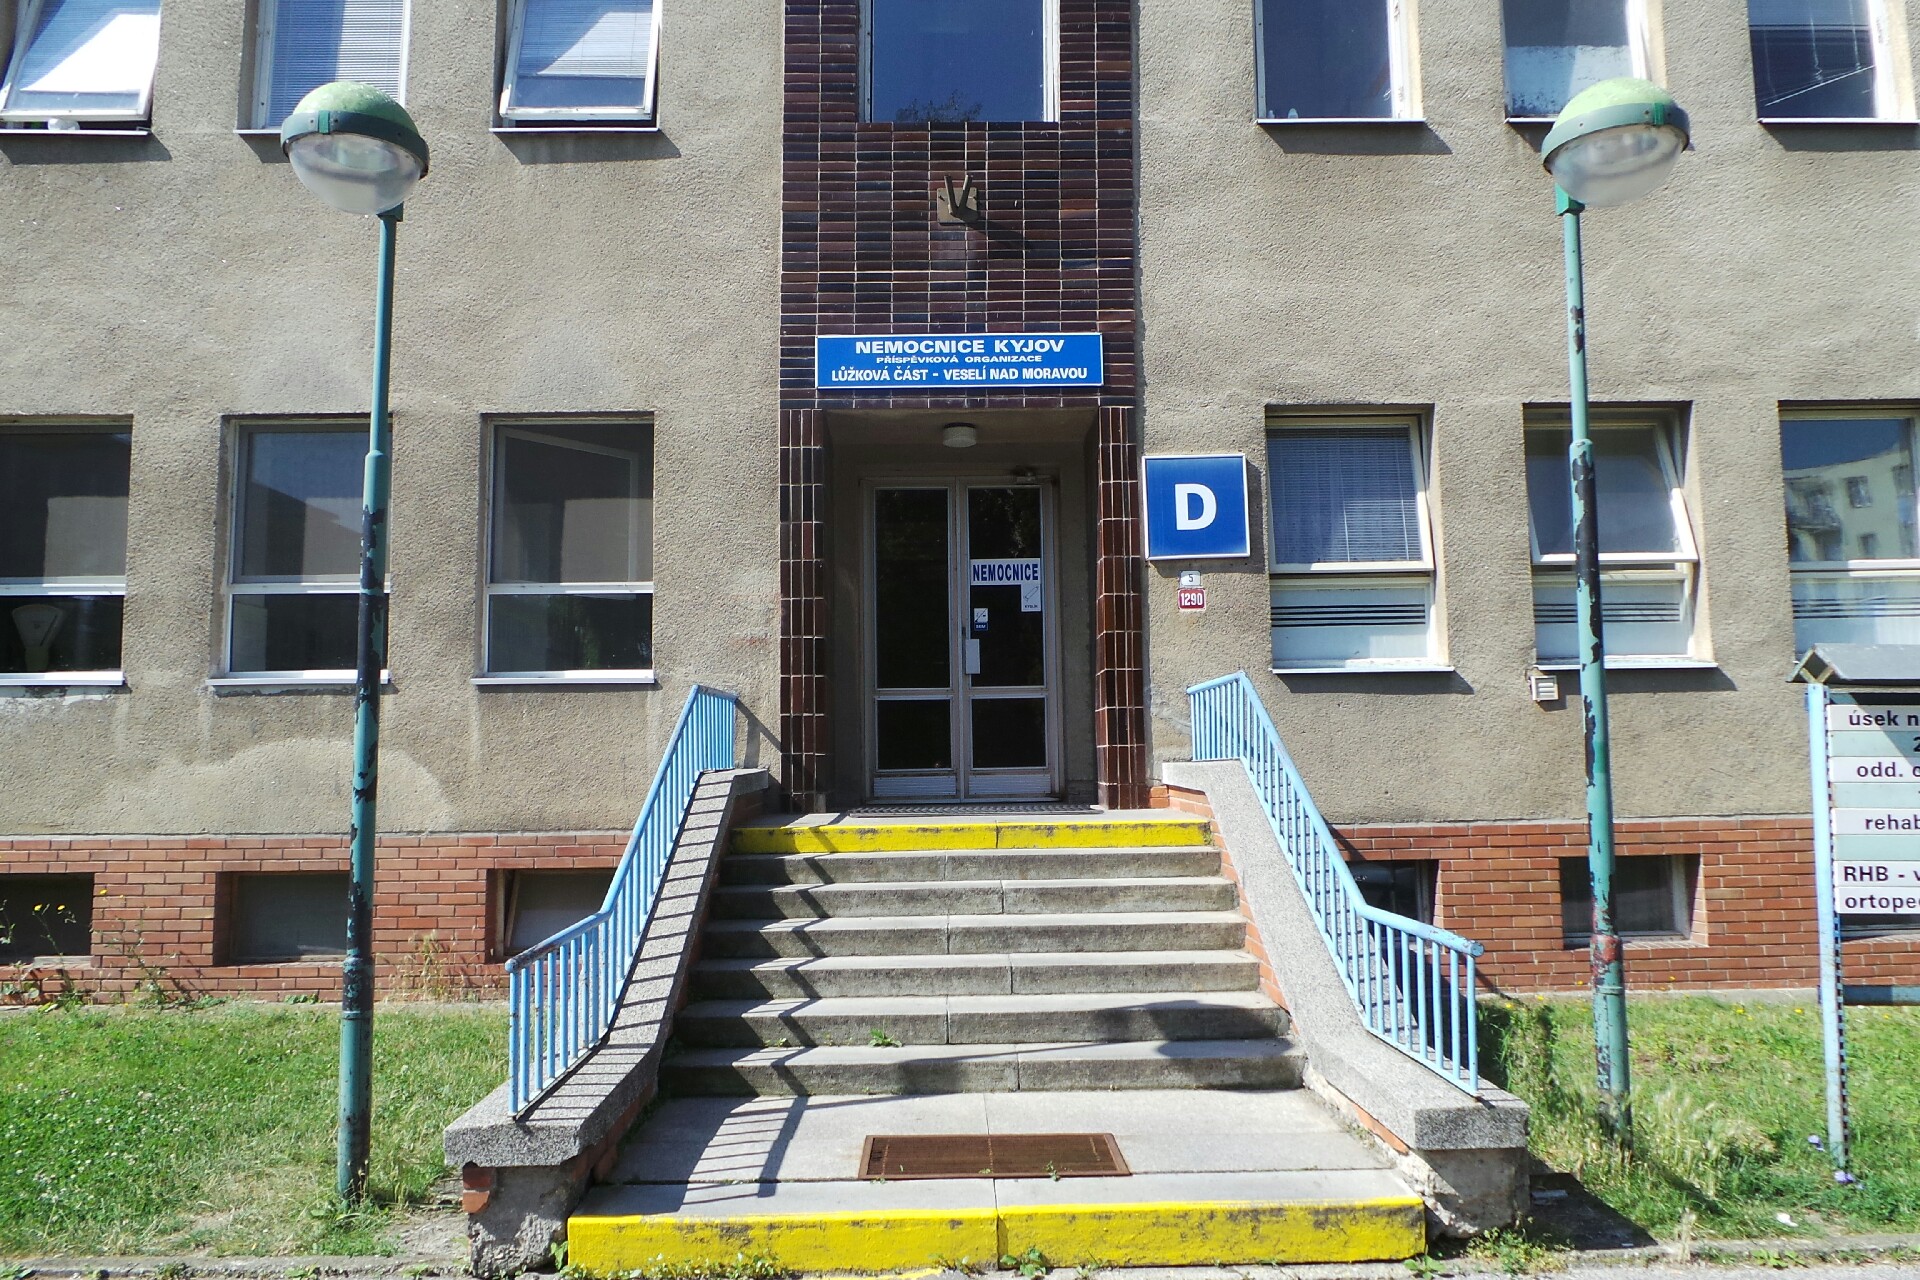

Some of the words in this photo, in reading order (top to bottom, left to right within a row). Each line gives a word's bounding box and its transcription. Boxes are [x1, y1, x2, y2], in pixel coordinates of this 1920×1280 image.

[855, 340, 985, 354] NEMOCNICE
[994, 339, 1065, 353] KYJOV
[876, 355, 959, 364] PŘÍSPĚVKOVÁ
[964, 355, 1043, 363] ORGANIZACE
[831, 366, 890, 382] LŮŽKOVÁ
[893, 365, 928, 381] ČÁST
[943, 365, 986, 380] VESELÍ
[989, 368, 1019, 380] NAD
[1022, 367, 1088, 379] MORAVOU
[1174, 483, 1218, 531] D
[972, 563, 1039, 582] NEMOCNICE
[1188, 573, 1194, 583] 5
[1180, 592, 1203, 606] 1290
[1849, 710, 1899, 726] úsek
[1857, 762, 1903, 777] odd.
[1843, 865, 1889, 882] RHB
[1844, 894, 1920, 912] ortope
